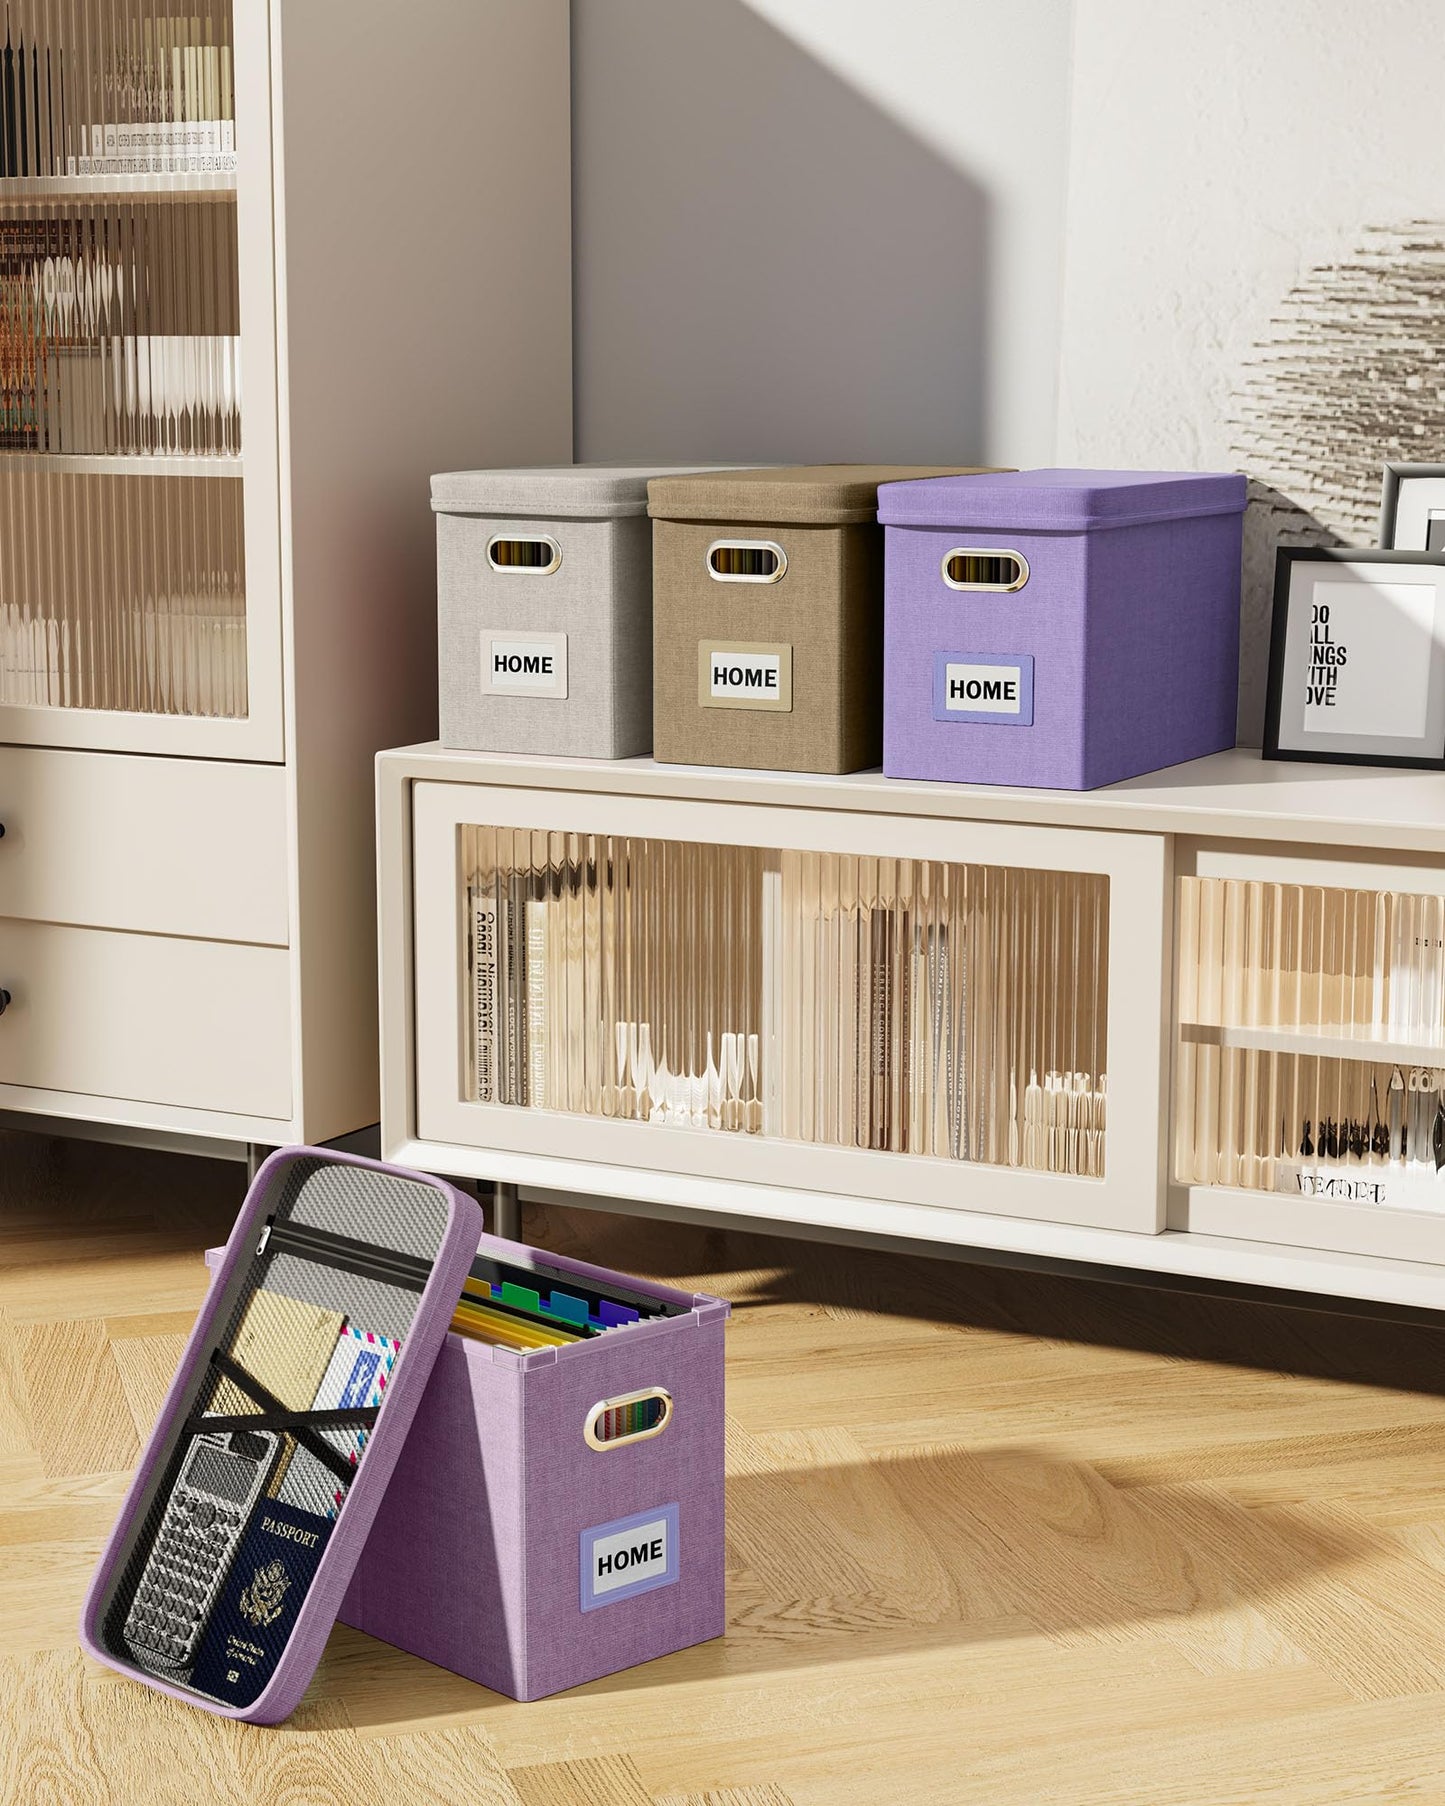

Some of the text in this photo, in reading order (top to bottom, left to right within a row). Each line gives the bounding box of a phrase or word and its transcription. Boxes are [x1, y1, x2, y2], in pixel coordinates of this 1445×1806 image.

[494, 654, 553, 674] HOME
[713, 666, 777, 688] HOME
[949, 679, 1016, 700] HOME
[260, 1516, 319, 1548] PASSPORT
[598, 1538, 663, 1577] HOME
